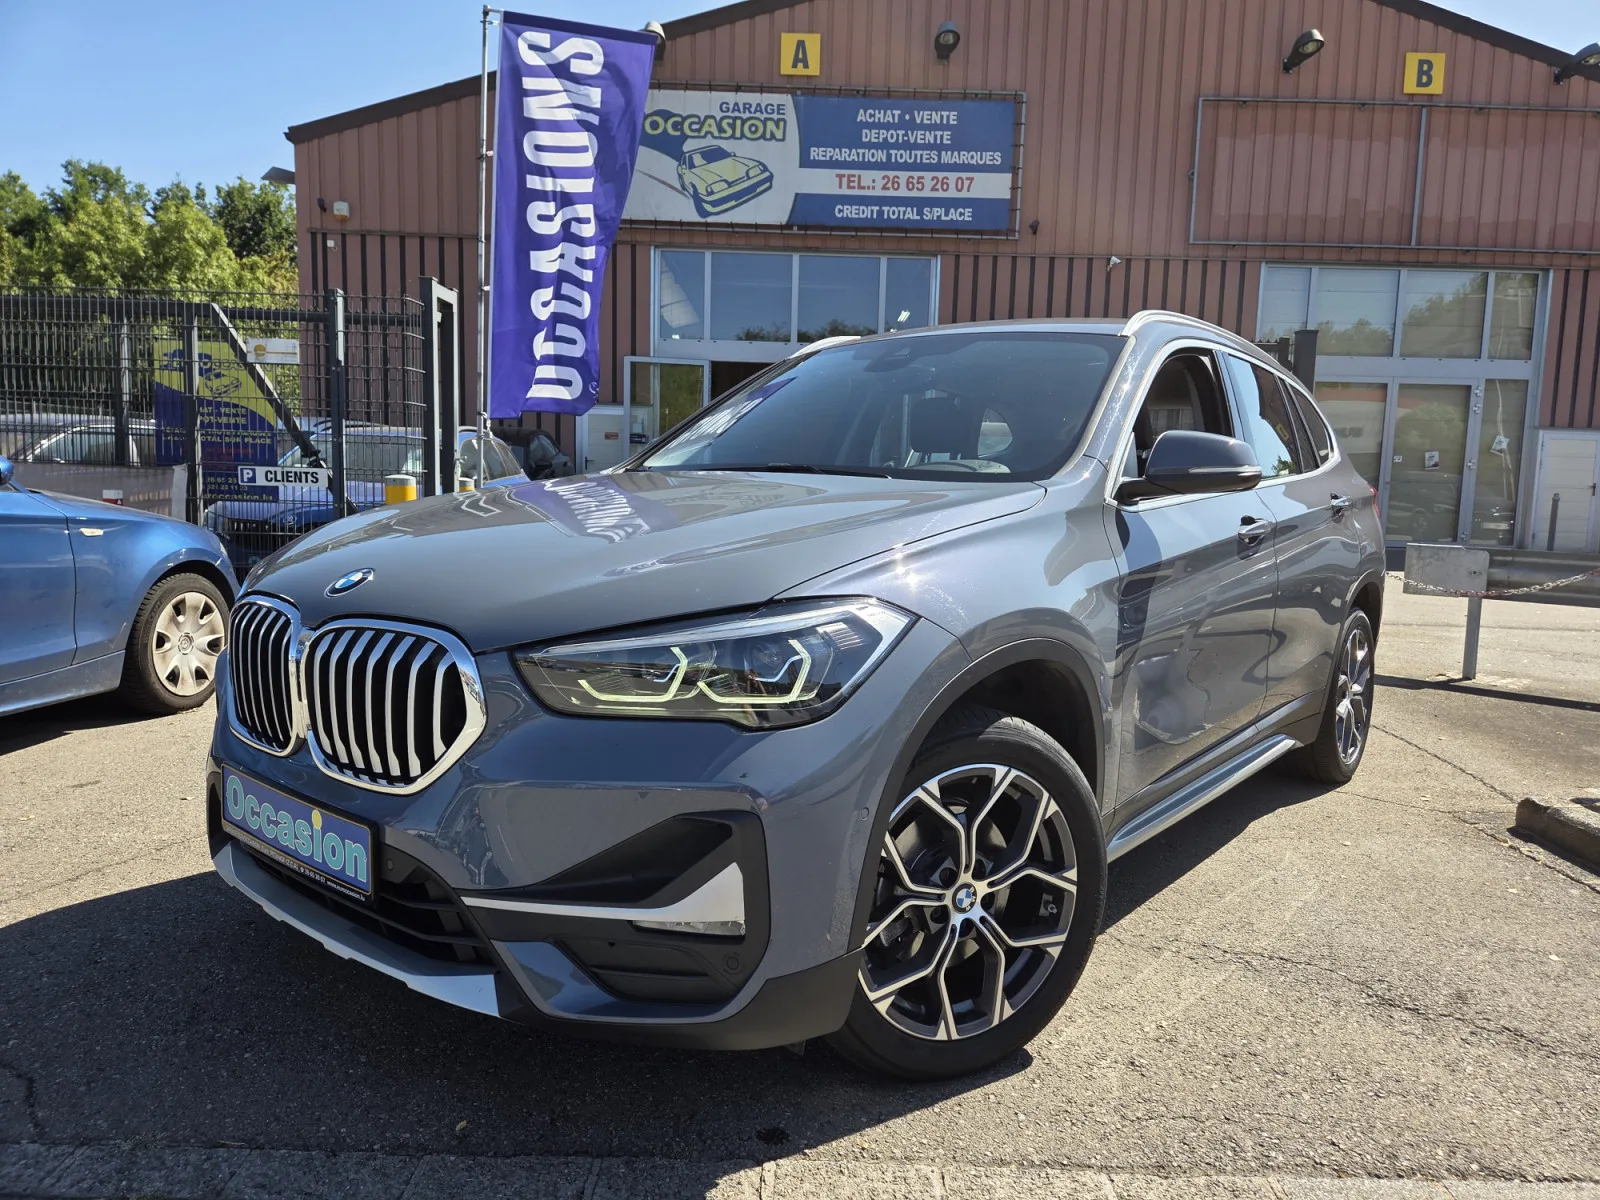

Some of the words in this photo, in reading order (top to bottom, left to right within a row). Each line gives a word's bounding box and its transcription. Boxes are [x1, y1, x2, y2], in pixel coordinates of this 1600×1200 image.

[791, 39, 810, 69] A
[1415, 59, 1434, 88] B
[719, 101, 786, 116] GARAGE
[856, 109, 901, 124] ACHAT
[914, 110, 958, 125] VENTE
[643, 114, 787, 141] OCCASION
[861, 129, 952, 145] DEPOT-VENTE
[809, 147, 887, 163] REPARATION
[889, 150, 938, 164] TOUTES
[940, 151, 1002, 166] MARQUES
[835, 173, 876, 191] TEL.:
[881, 174, 901, 192] 26
[905, 175, 925, 192] 65
[930, 175, 950, 193] 26
[954, 176, 975, 193] 07
[517, 31, 604, 401] OCCASIONS
[834, 205, 880, 219] CREDIT
[881, 206, 921, 220] TOTAL
[923, 207, 973, 221] S/PLACE
[244, 436, 272, 444] PLACE
[243, 469, 253, 482] P
[264, 469, 319, 485] CLIENTS
[226, 774, 367, 883] Occasion
